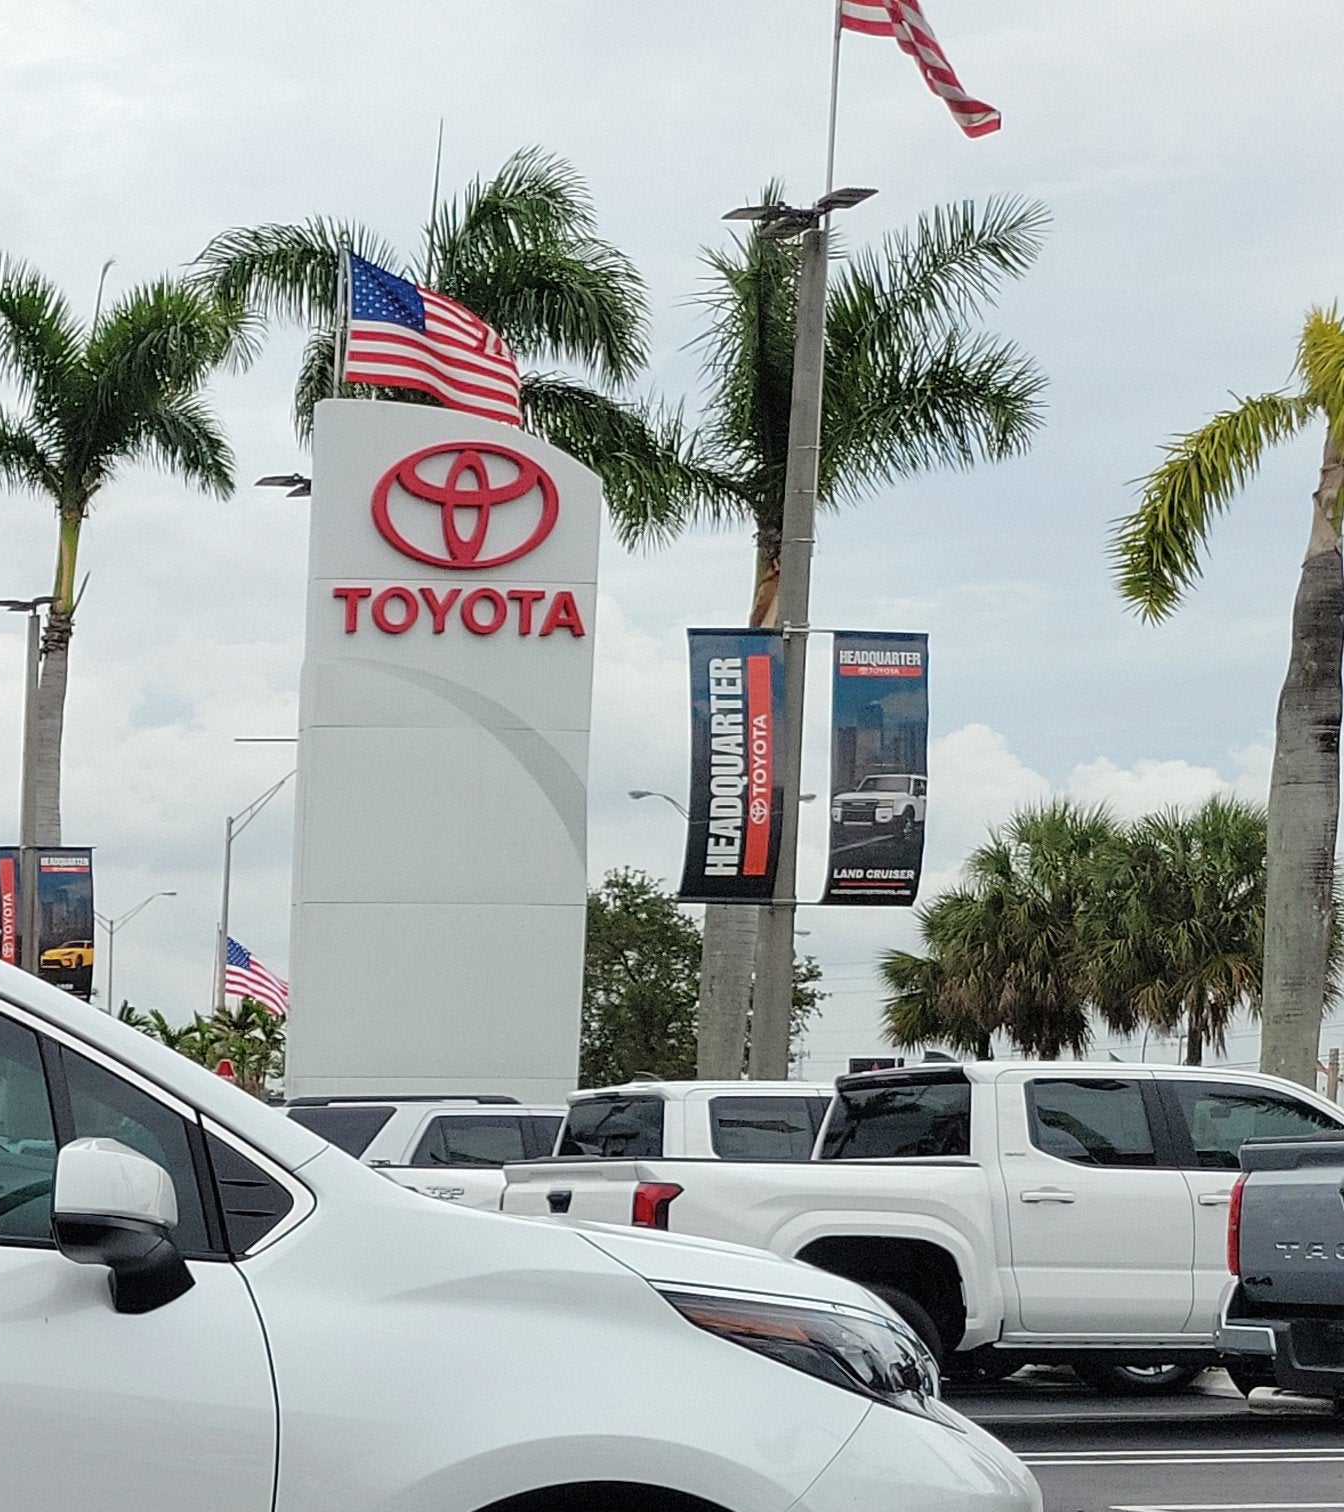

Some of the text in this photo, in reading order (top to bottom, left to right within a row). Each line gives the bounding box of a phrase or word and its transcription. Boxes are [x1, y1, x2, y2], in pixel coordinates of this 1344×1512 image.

[332, 585, 586, 638] TOYOTA
[840, 650, 921, 666] HEADQUARTER
[704, 657, 748, 877] HEADQUARTER
[752, 714, 768, 797] TOYOTA
[833, 868, 915, 880] LAND CRUISER
[2, 893, 14, 943] TOYOTA
